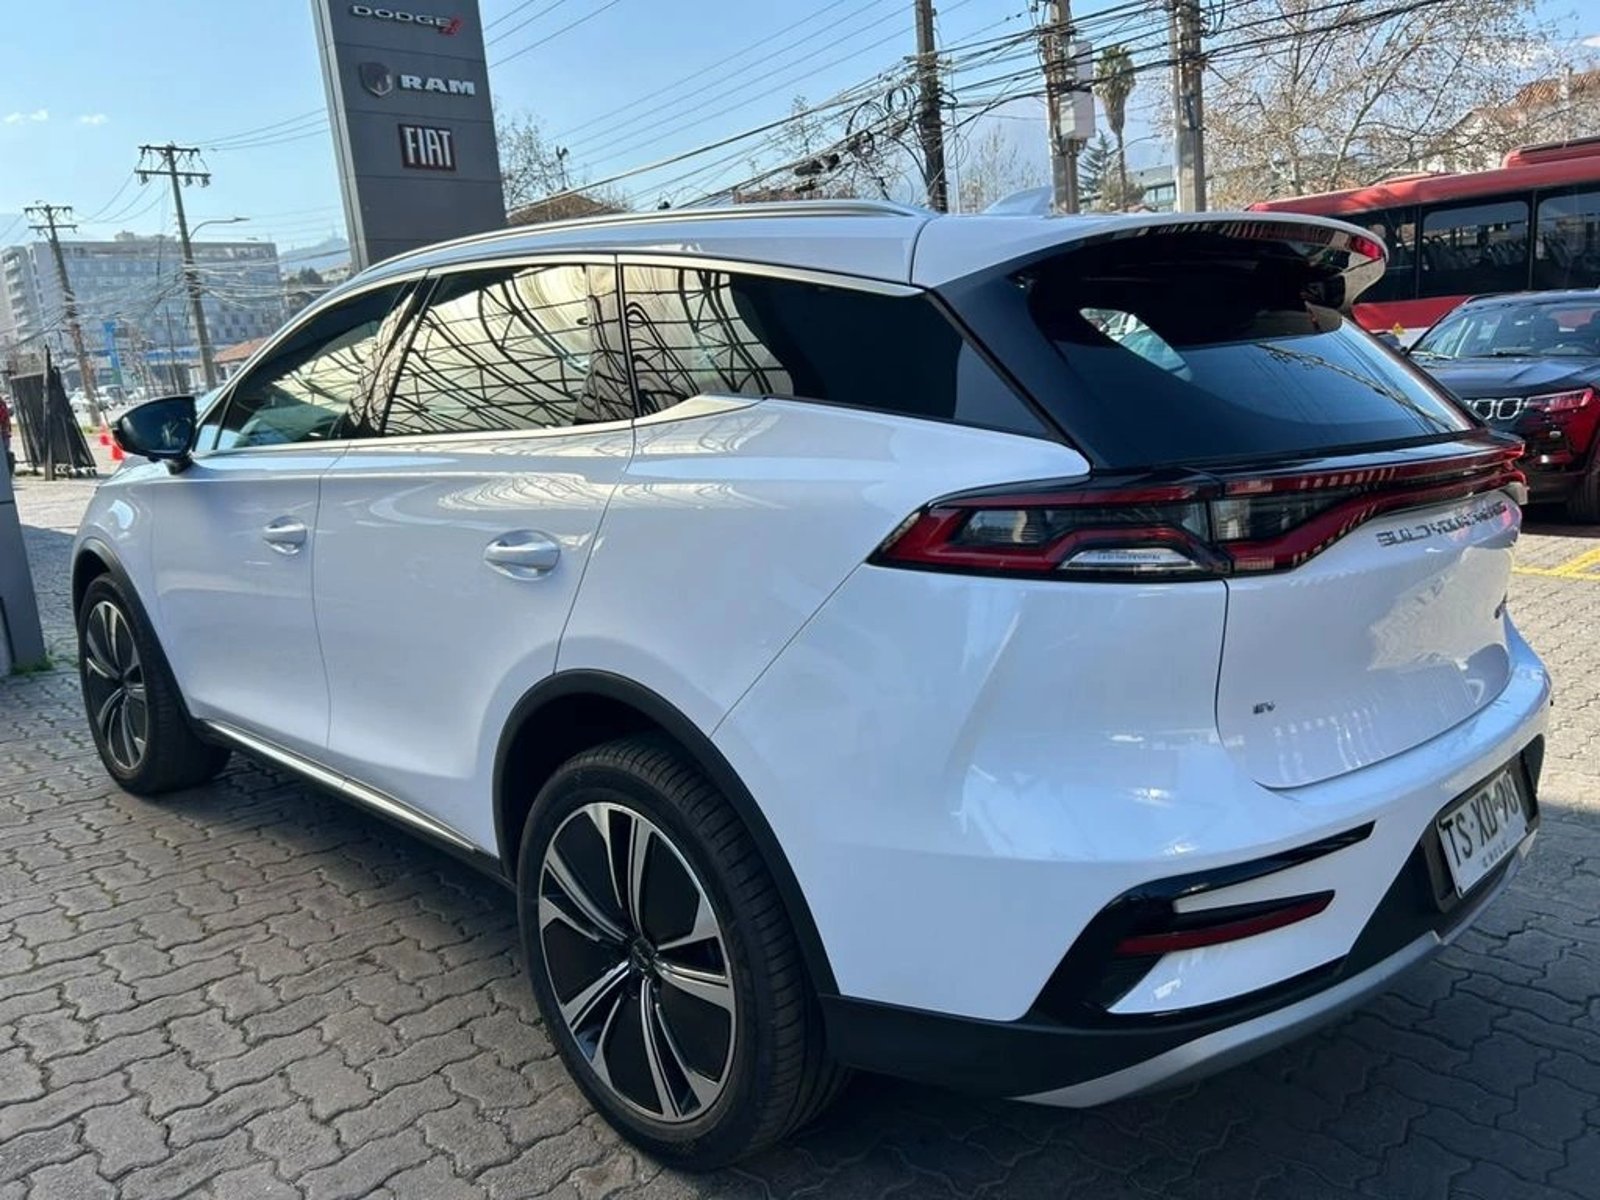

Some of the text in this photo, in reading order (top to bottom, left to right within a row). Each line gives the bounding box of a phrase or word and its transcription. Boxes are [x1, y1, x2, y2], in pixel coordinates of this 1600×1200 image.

[351, 5, 452, 28] DODGE
[400, 74, 476, 95] RAM
[403, 126, 451, 167] FIAT
